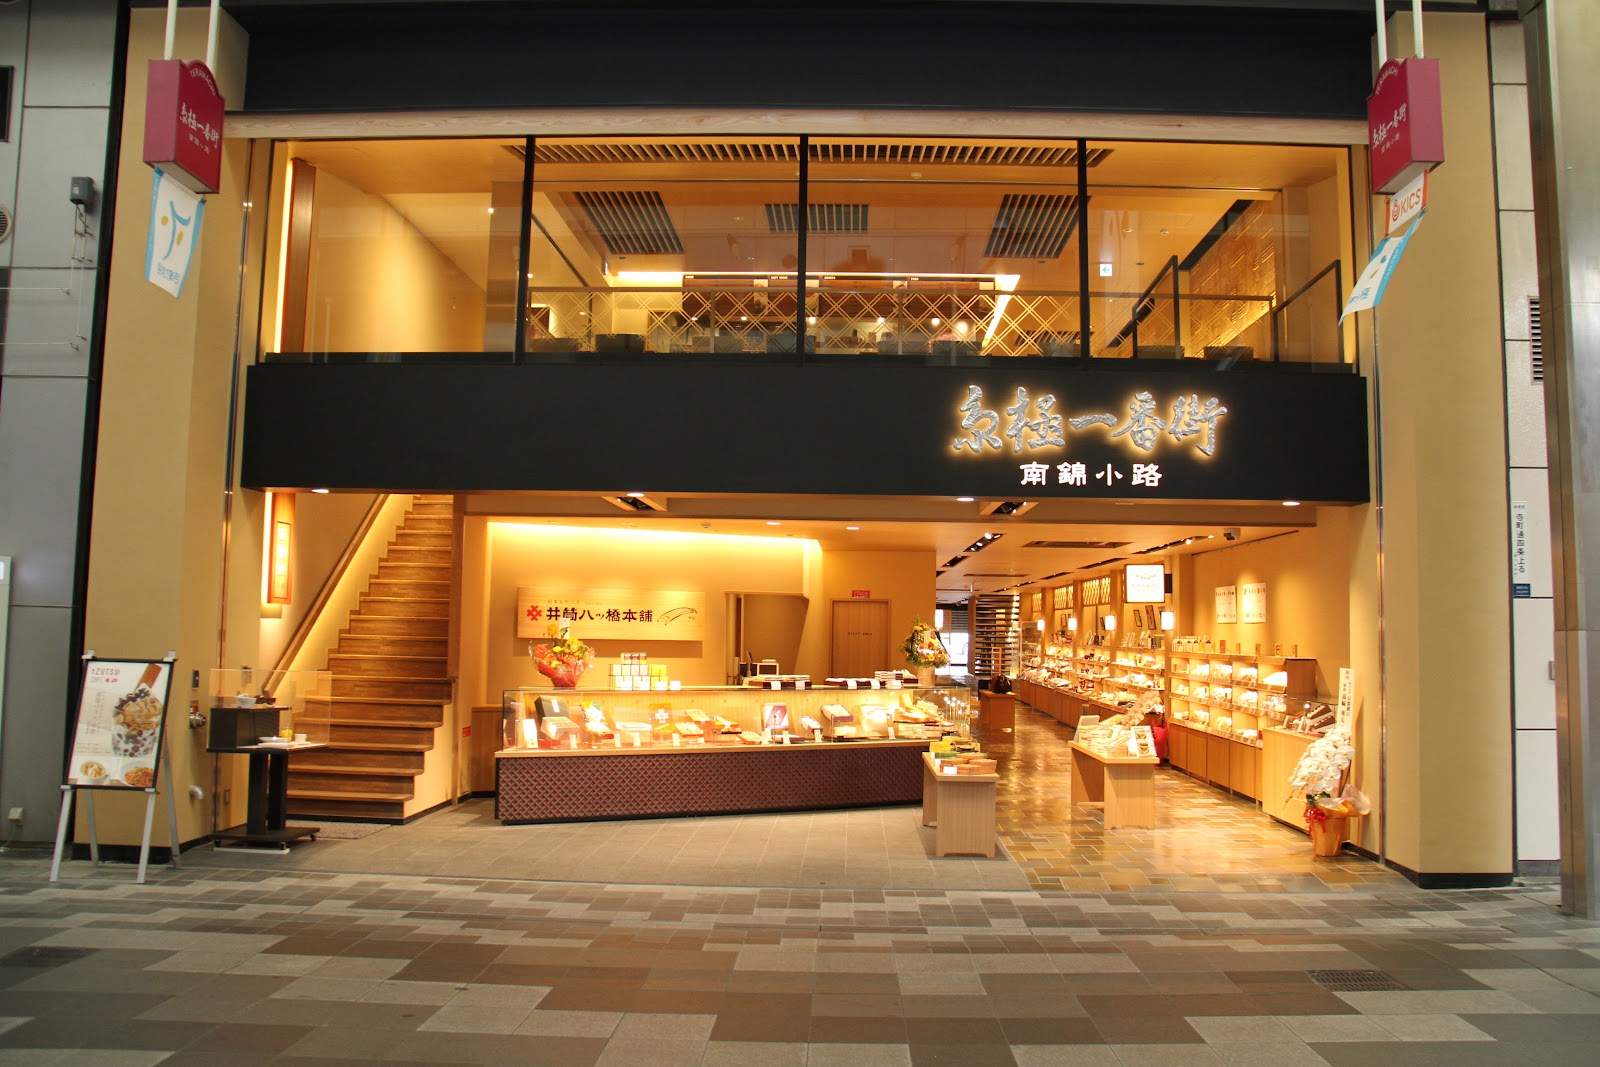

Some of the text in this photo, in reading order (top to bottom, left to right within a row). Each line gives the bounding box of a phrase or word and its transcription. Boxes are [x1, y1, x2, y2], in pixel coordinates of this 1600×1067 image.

[180, 101, 220, 149] 京極一番街
[1372, 102, 1407, 150] 京極一番街
[1400, 188, 1421, 217] KICS
[952, 384, 1228, 456] 京極一番街
[1019, 461, 1163, 487] 南錦小路
